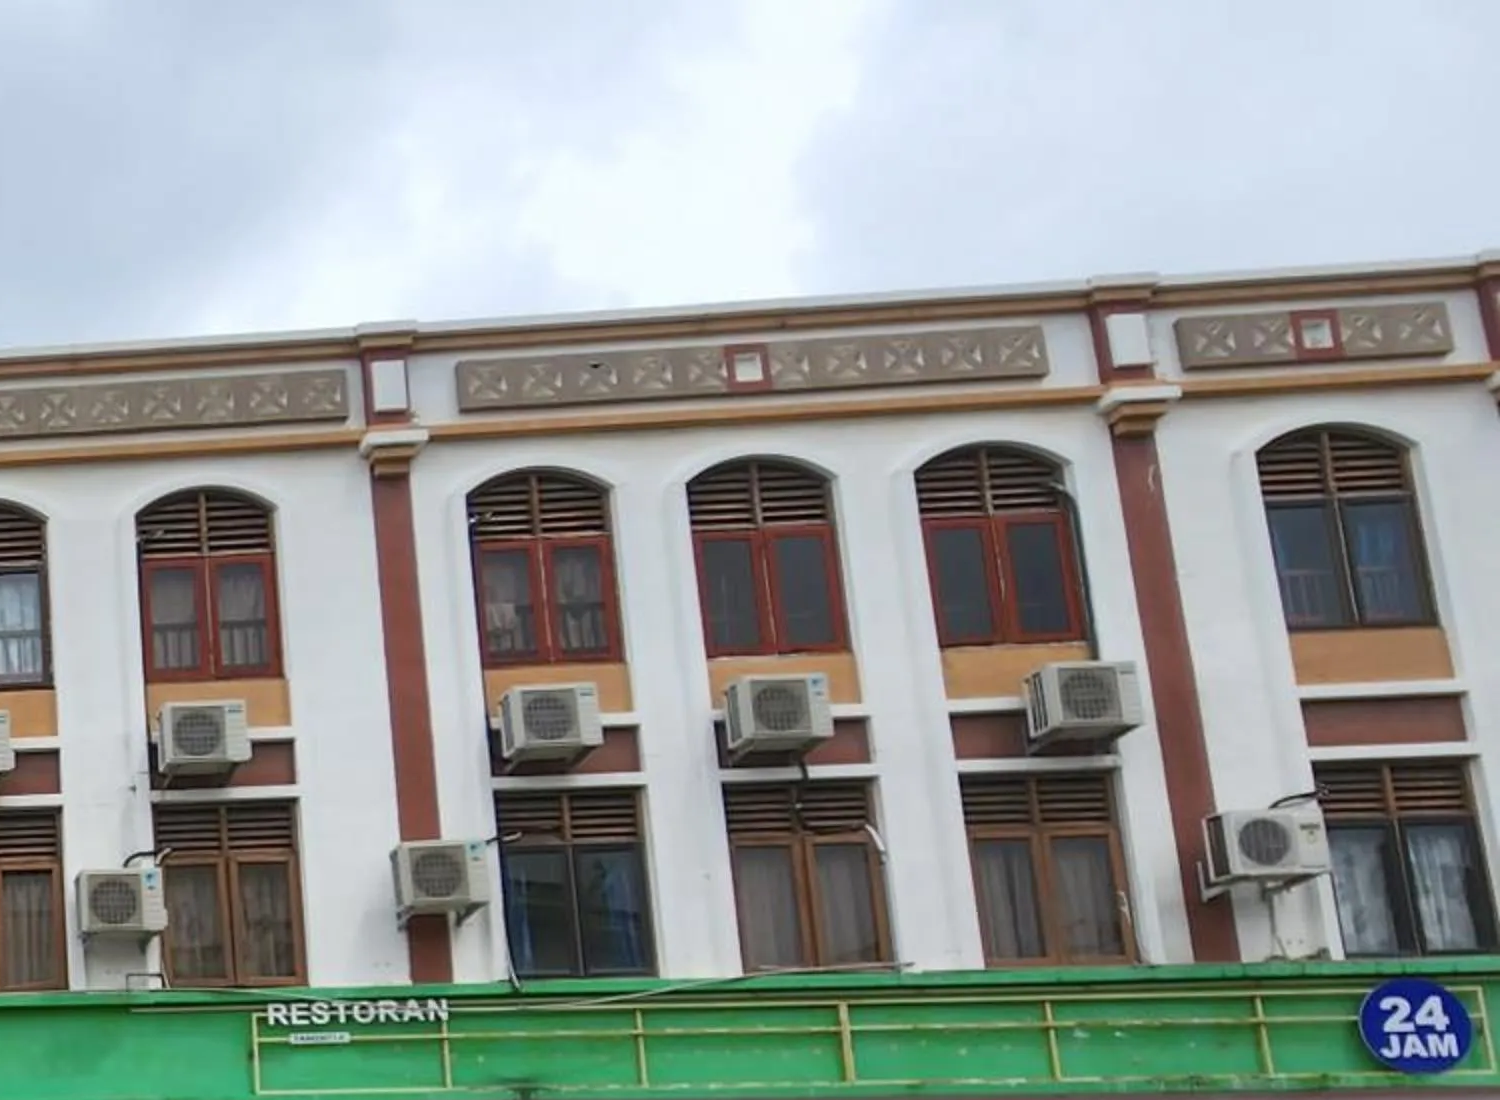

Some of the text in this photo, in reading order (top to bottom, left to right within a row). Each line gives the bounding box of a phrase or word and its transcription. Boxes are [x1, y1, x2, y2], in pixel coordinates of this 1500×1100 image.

[267, 998, 449, 1026] RESTORAN
[1380, 995, 1450, 1032] 24
[1380, 1033, 1459, 1058] JAM
